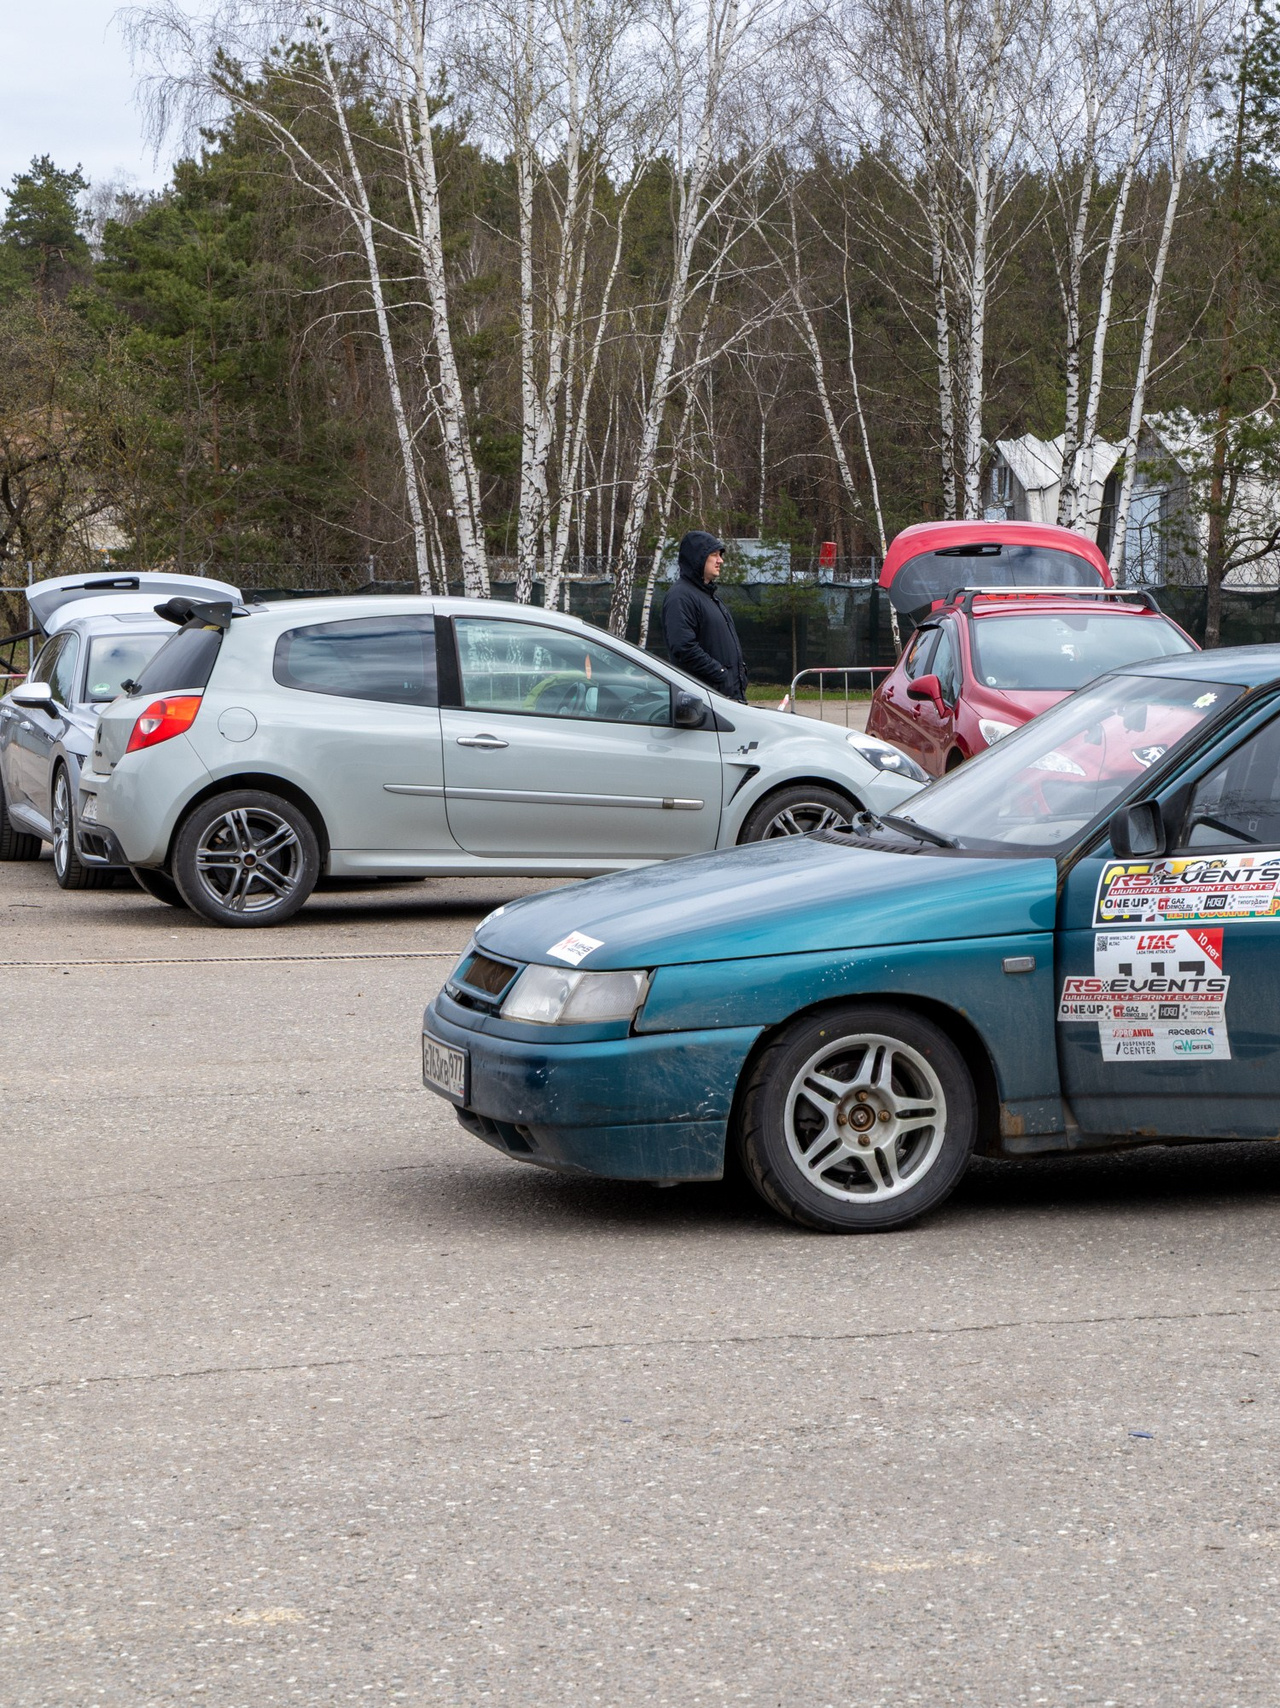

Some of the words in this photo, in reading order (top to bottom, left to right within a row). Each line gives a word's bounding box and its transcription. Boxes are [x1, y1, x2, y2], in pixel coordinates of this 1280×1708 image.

[1112, 873, 1153, 887] RS
[1159, 867, 1280, 885] EVENTS
[1136, 934, 1179, 950] LTAC
[1197, 932, 1208, 946] 10
[1205, 944, 1220, 960] лет
[1065, 980, 1102, 992] RS
[1109, 979, 1226, 992] EVENTS
[1123, 1047, 1156, 1055] CENTER
